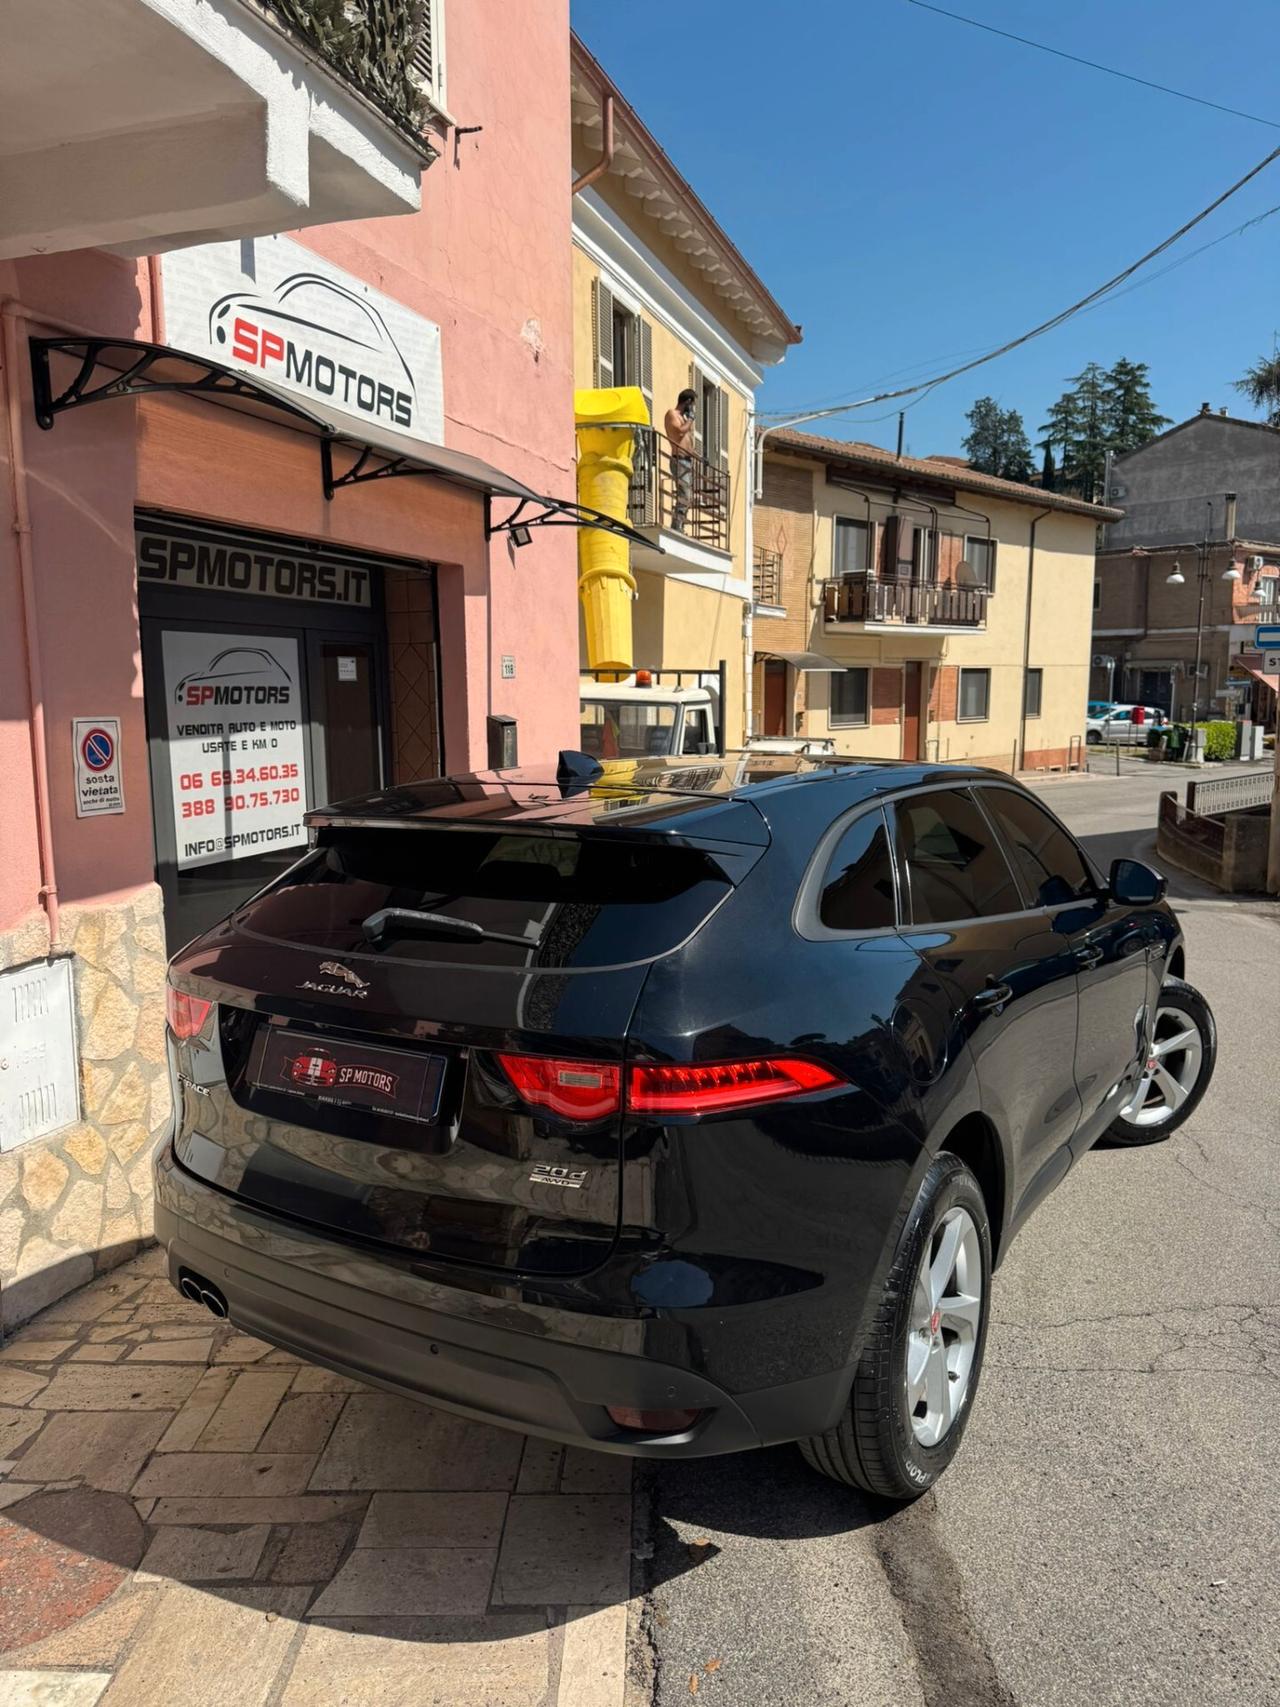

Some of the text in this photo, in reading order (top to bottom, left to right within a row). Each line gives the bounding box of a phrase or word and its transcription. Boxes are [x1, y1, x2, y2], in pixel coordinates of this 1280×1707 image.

[232, 317, 412, 428] SPMOTORS
[139, 537, 367, 603] SPMOTORS.IT
[186, 686, 290, 706] SPMOTORS
[177, 720, 296, 737] VENDITA AUTO E MOTO
[202, 740, 237, 753] USATE
[242, 740, 248, 750] E
[252, 739, 267, 750] KM
[86, 774, 115, 784] sosta
[180, 763, 299, 790] 06 69.34.60.35
[81, 785, 118, 797] vietata
[181, 788, 300, 818] 388 90.75.730
[185, 823, 301, 857] INFO@SPMOTORS.IT
[296, 981, 367, 999] JAGUAR
[339, 1067, 393, 1092] SP MOTORS
[541, 1177, 570, 1185] AWD
